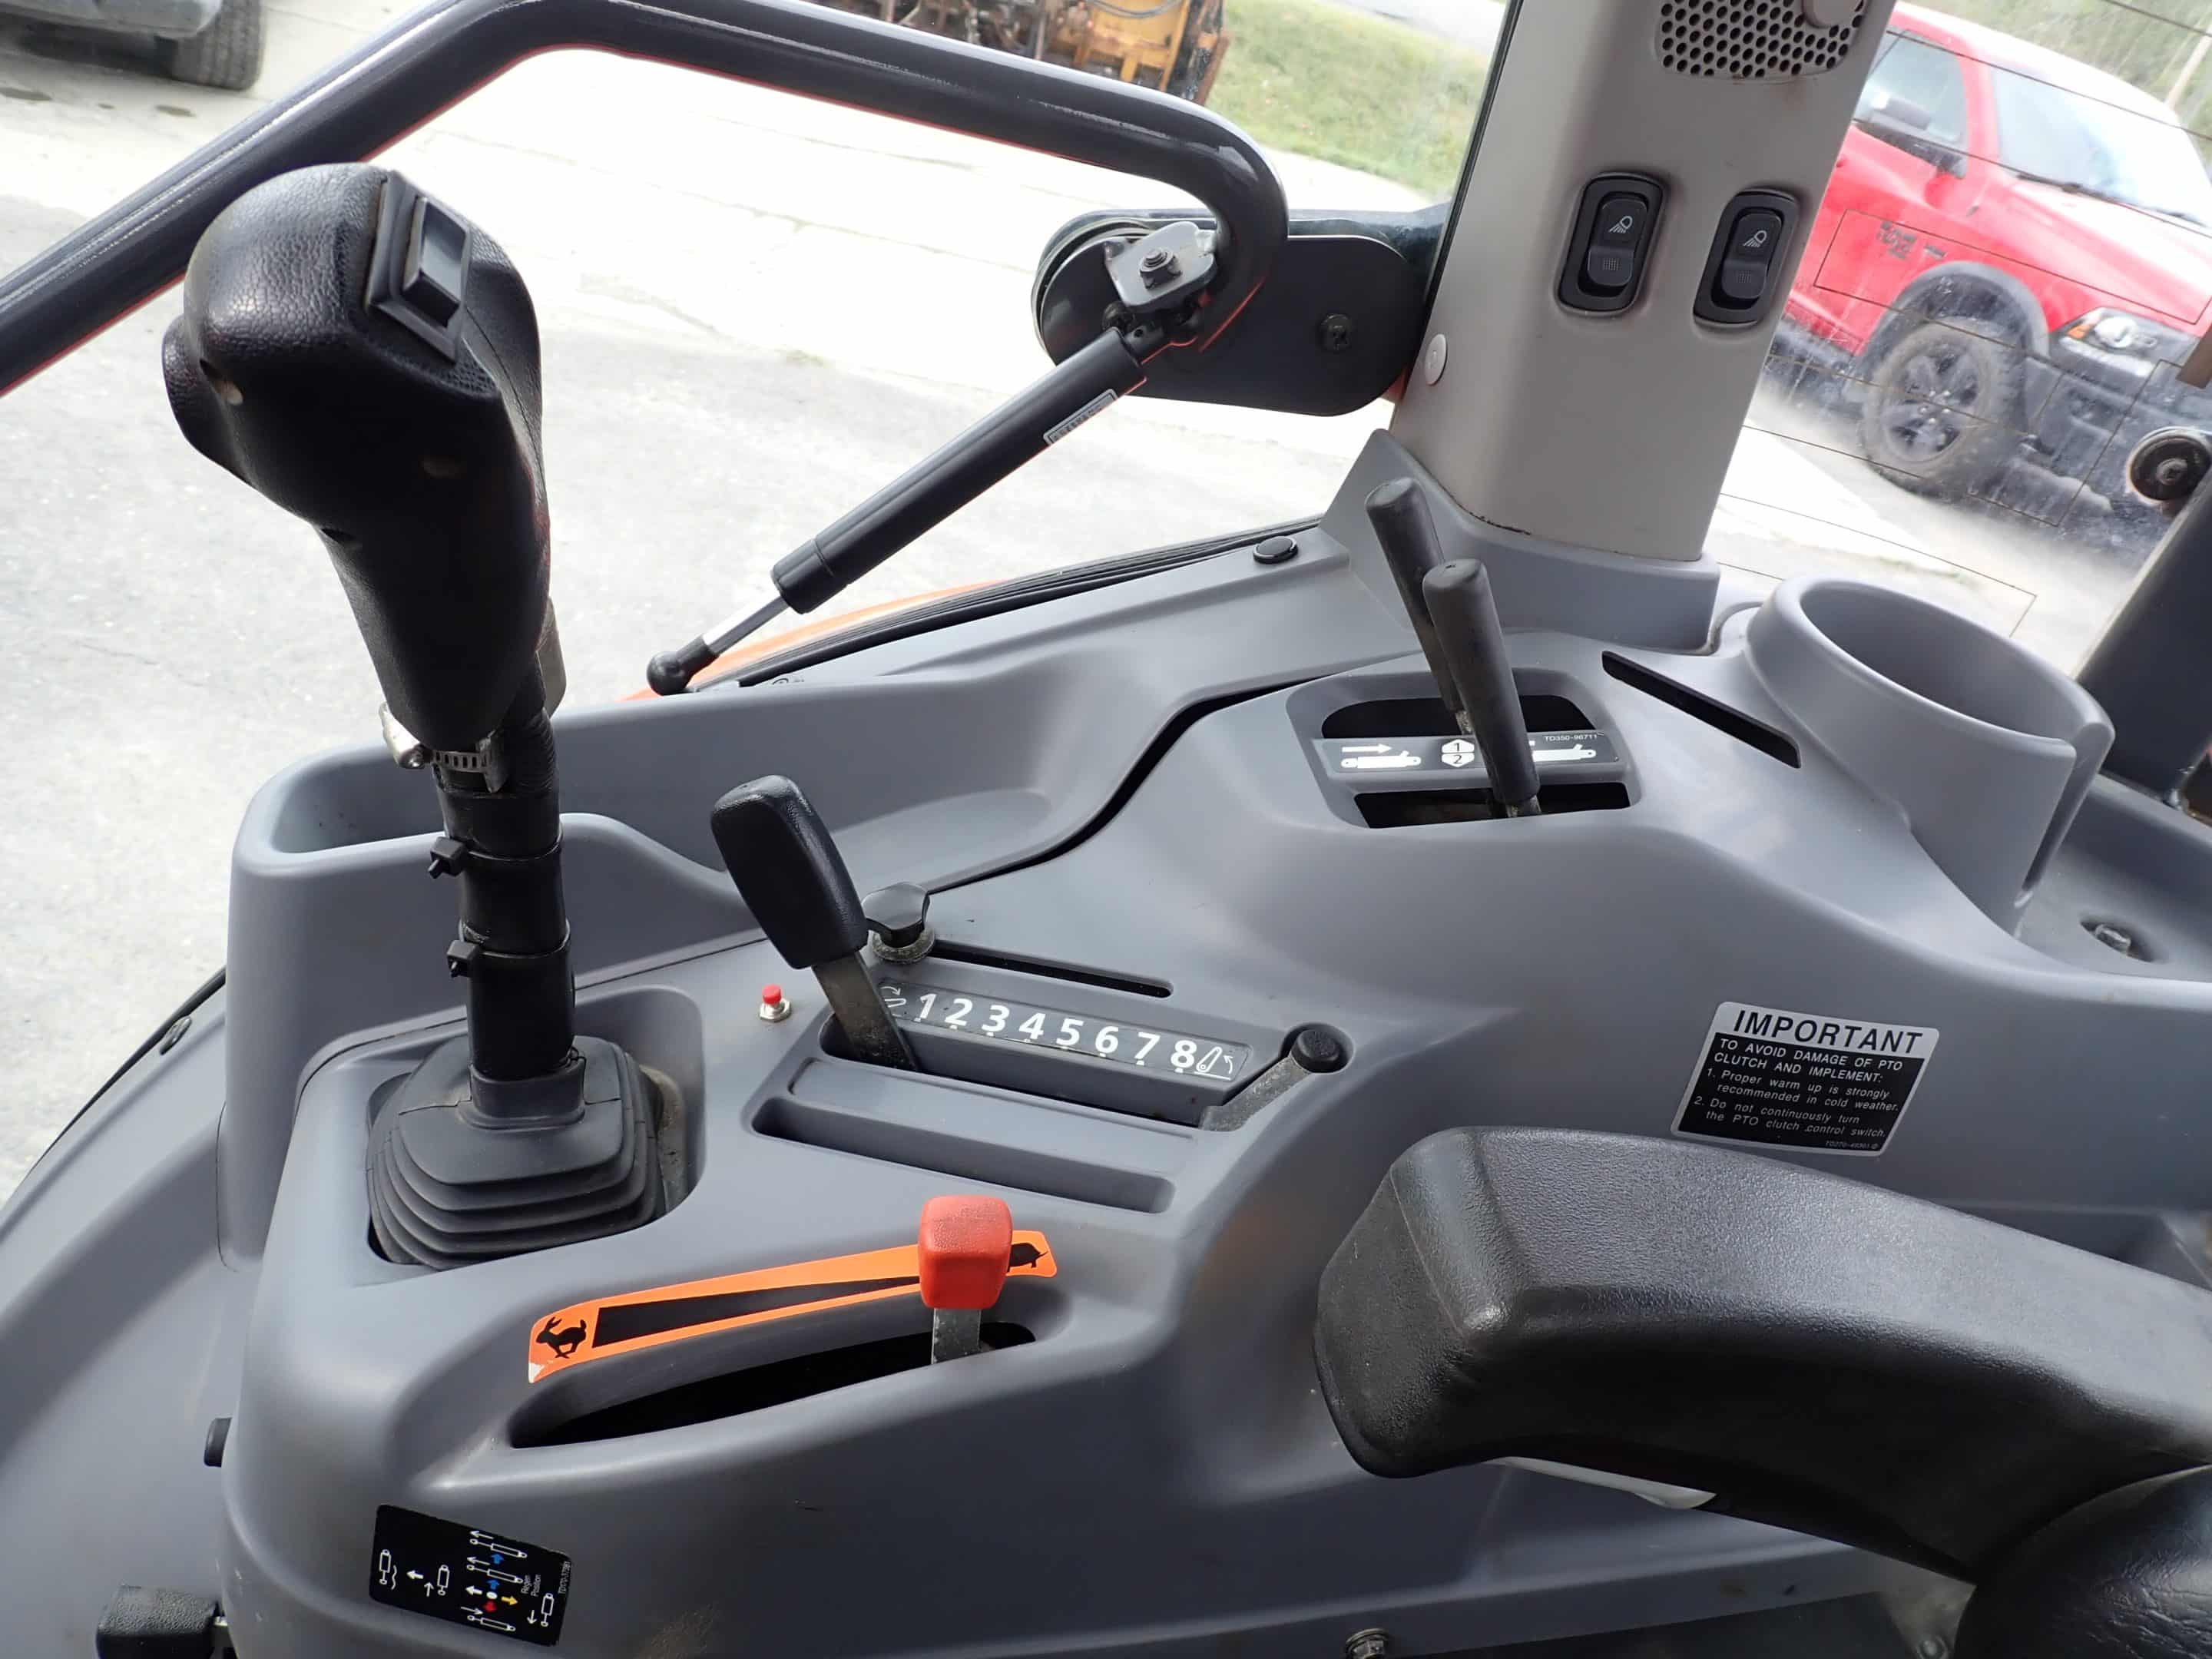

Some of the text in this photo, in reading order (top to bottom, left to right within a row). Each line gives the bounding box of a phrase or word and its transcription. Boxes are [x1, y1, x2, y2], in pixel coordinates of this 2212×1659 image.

[919, 993, 1198, 1068] 1 2 3 4 5 6 7 8
[1734, 1009, 1923, 1054] IMPORTANT
[1714, 1051, 1883, 1083] CLUTCH AND IMPLEMENT:
[1720, 1038, 1903, 1071] TO AVOID DAMAGE OF PTO
[1706, 1068, 1890, 1100] 1. Proper warm up is strongly
[1717, 1084, 1899, 1111] recommended in cold weather.
[1694, 1095, 1860, 1124] 2. Do not continuously turn
[1706, 1111, 1724, 1121] the
[1732, 1114, 1759, 1126] PTO
[1766, 1119, 1800, 1131] clutch
[1850, 1128, 1886, 1137] switch.
